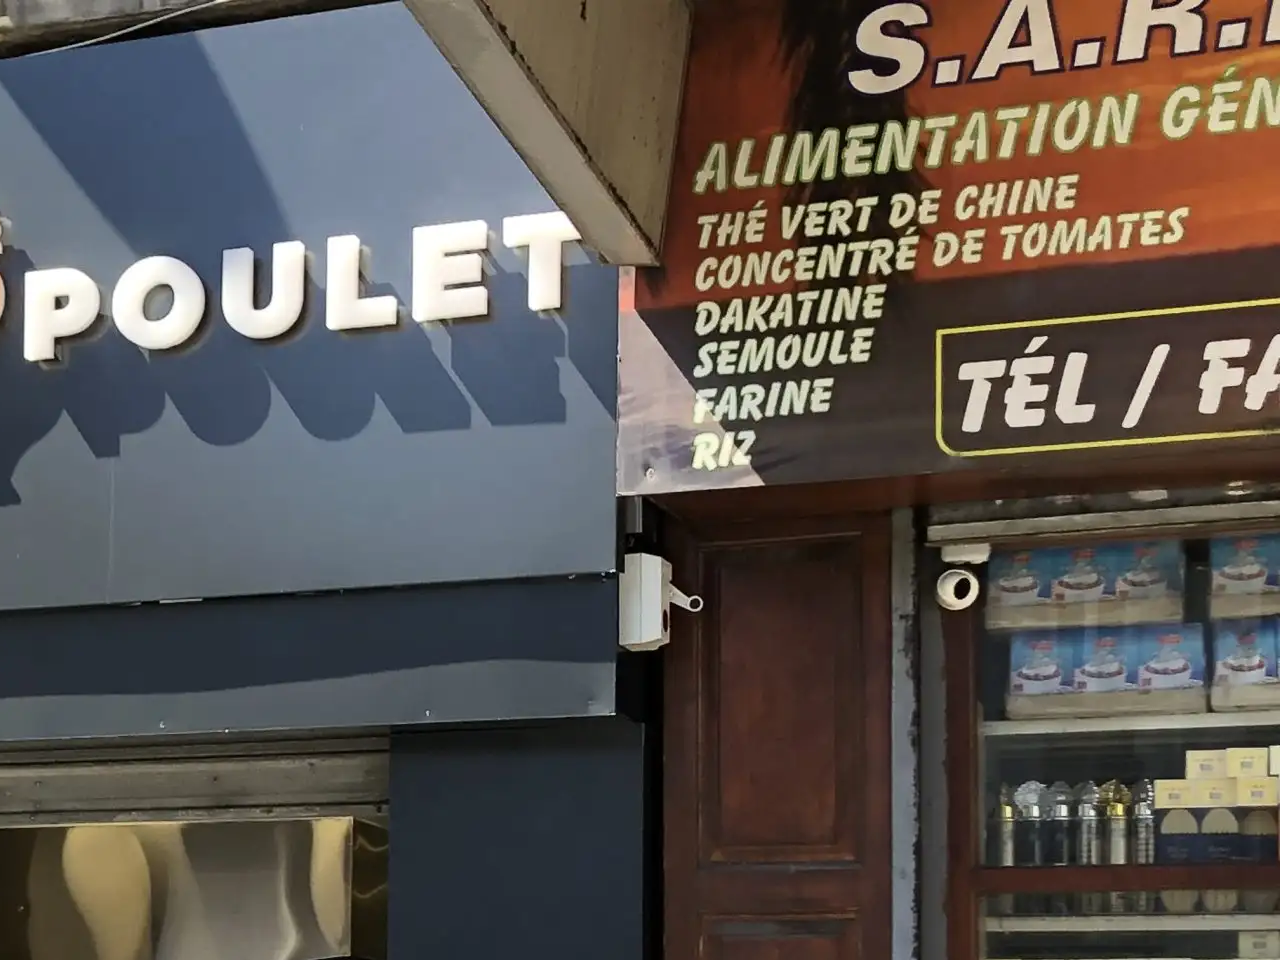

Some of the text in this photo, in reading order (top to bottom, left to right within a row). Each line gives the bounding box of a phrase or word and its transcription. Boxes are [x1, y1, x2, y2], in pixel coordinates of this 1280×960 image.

[848, 0, 1280, 95] S.A.R.
[694, 92, 1139, 194] ALIMENTATION
[695, 206, 1190, 292] CONCENTRÉ DE TOMATES
[697, 173, 1080, 249] THÉ VERT DE CHINE
[23, 210, 584, 364] POULET
[694, 284, 887, 336] DAKATINE
[693, 327, 875, 378] SEMOULE
[957, 336, 1097, 434] TÉL
[693, 377, 835, 424] FARINE
[692, 430, 757, 472] RIZ
